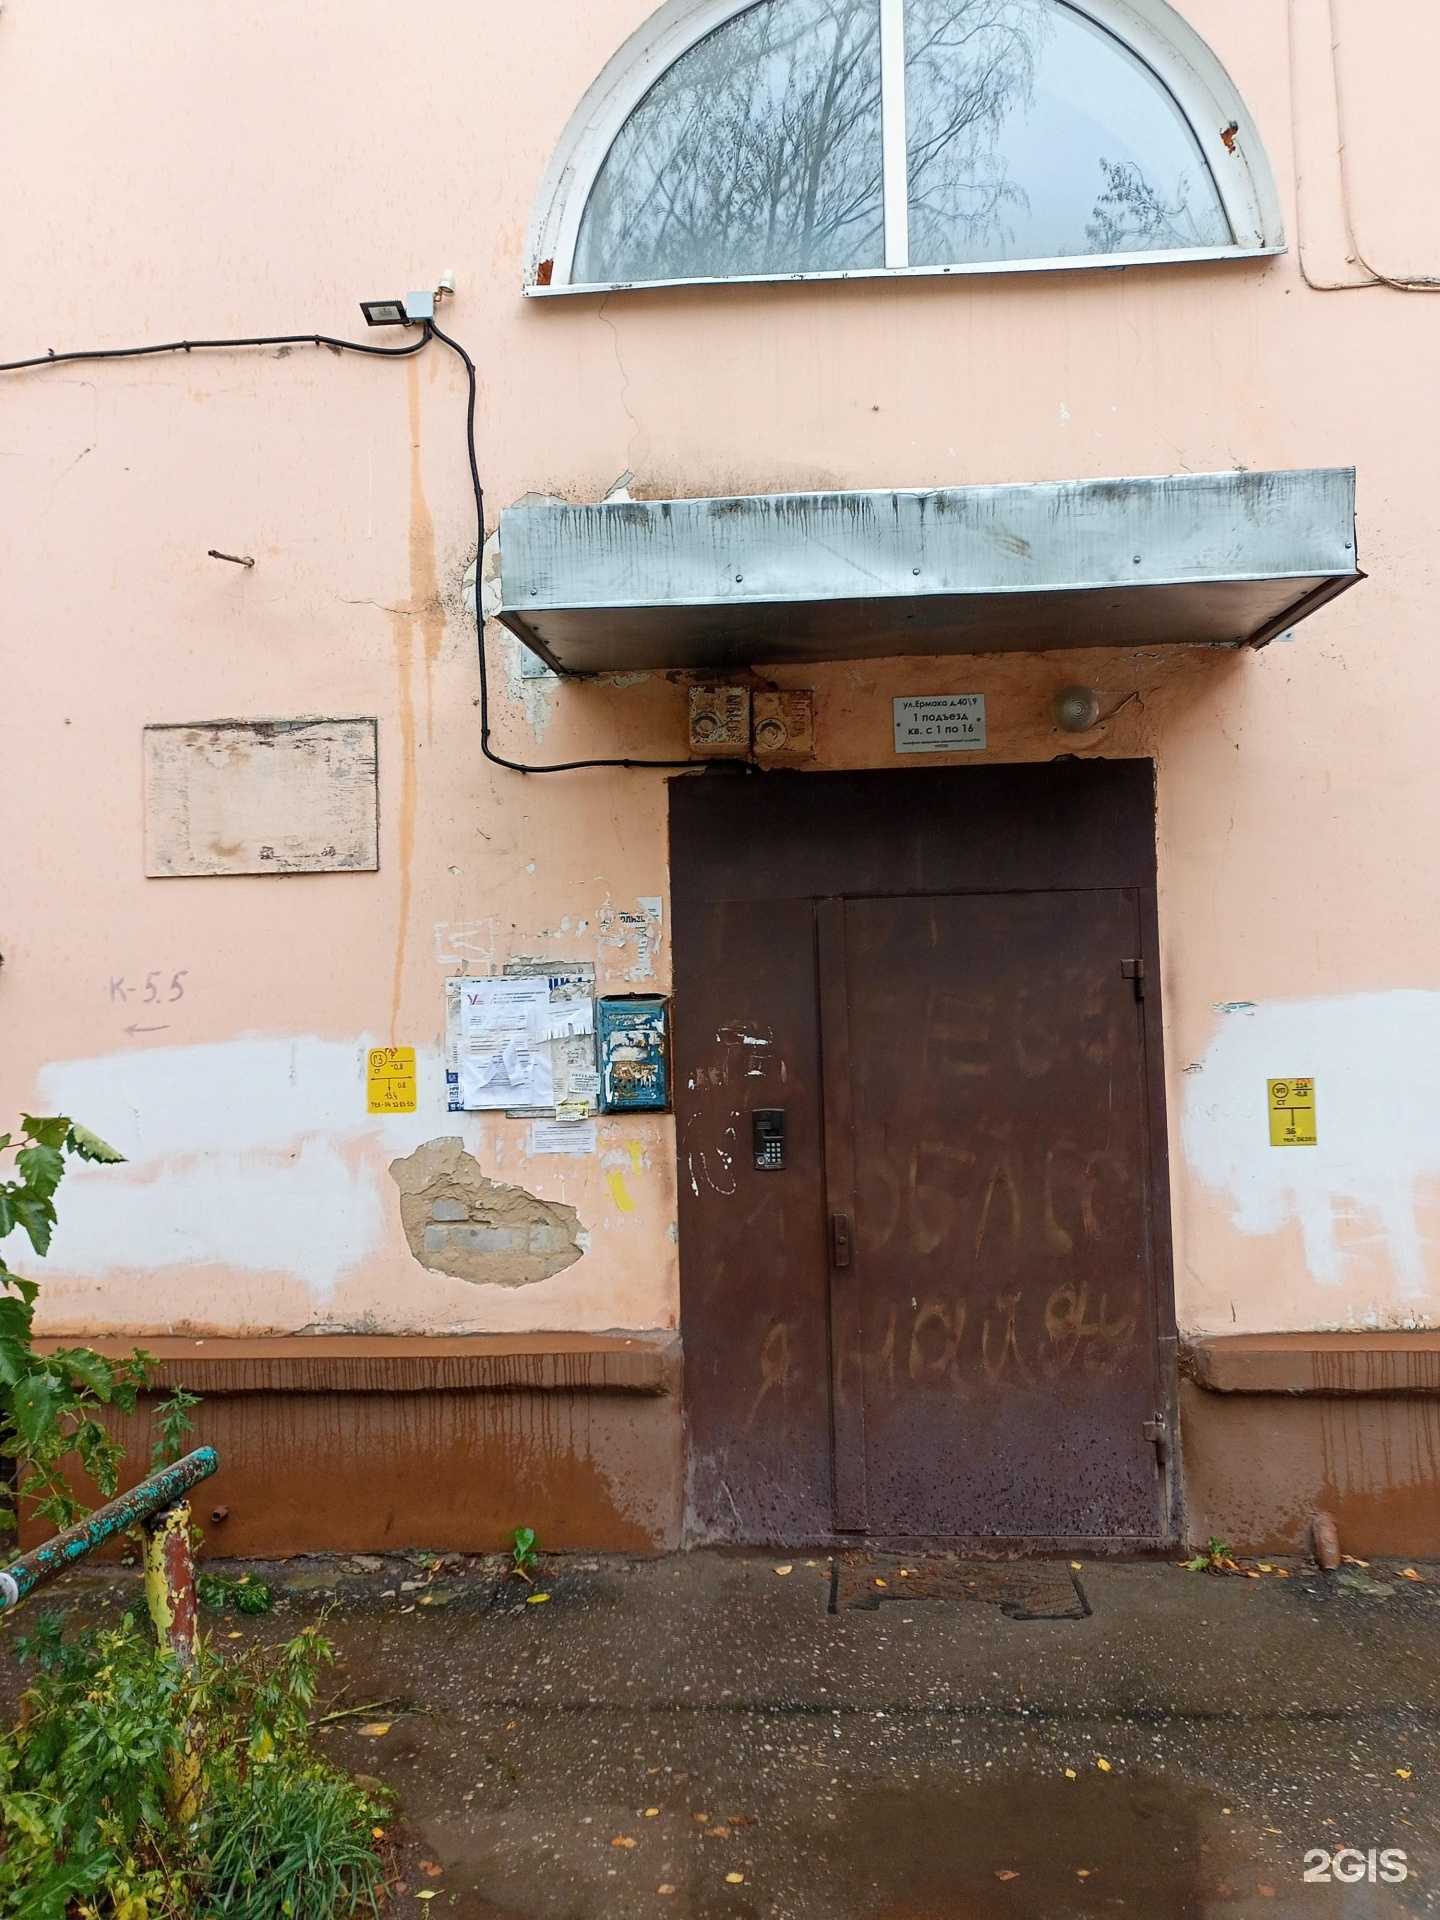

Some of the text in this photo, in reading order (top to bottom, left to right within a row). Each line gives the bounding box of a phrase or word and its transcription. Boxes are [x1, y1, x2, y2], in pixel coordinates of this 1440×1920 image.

[913, 712, 969, 722] 1 подъезд
[907, 727, 923, 735] кв.
[926, 726, 933, 734] с
[945, 726, 959, 734] по
[962, 723, 975, 733] 16
